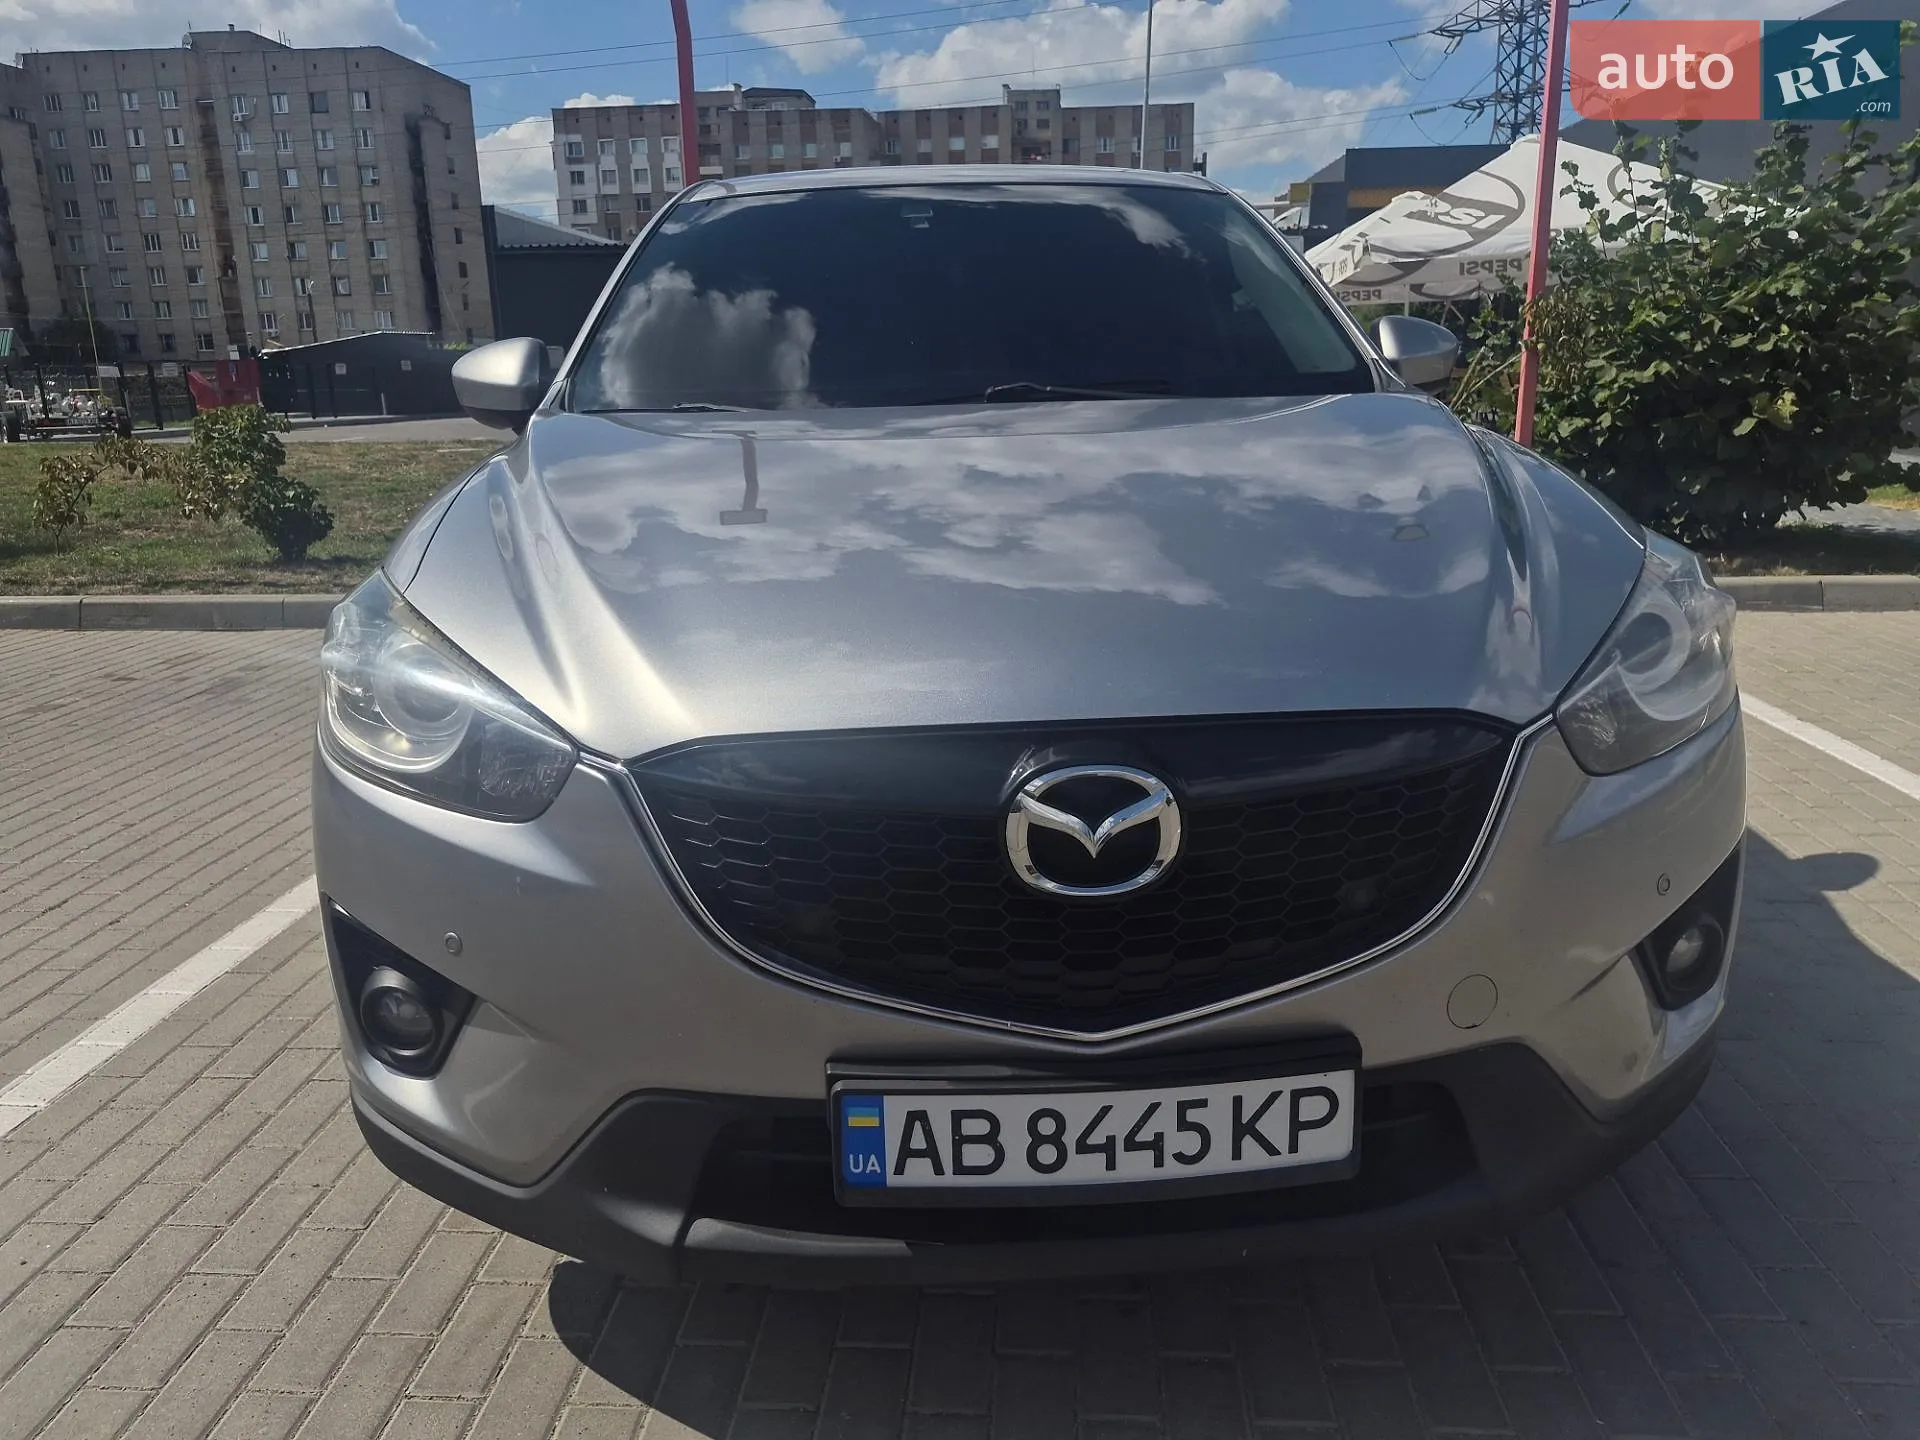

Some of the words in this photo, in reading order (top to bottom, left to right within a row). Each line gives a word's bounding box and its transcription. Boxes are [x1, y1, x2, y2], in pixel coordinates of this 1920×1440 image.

[893, 1109, 1005, 1176] AB
[1026, 1098, 1213, 1174] 8445
[1231, 1086, 1340, 1160] KP
[849, 1154, 882, 1174] UA
